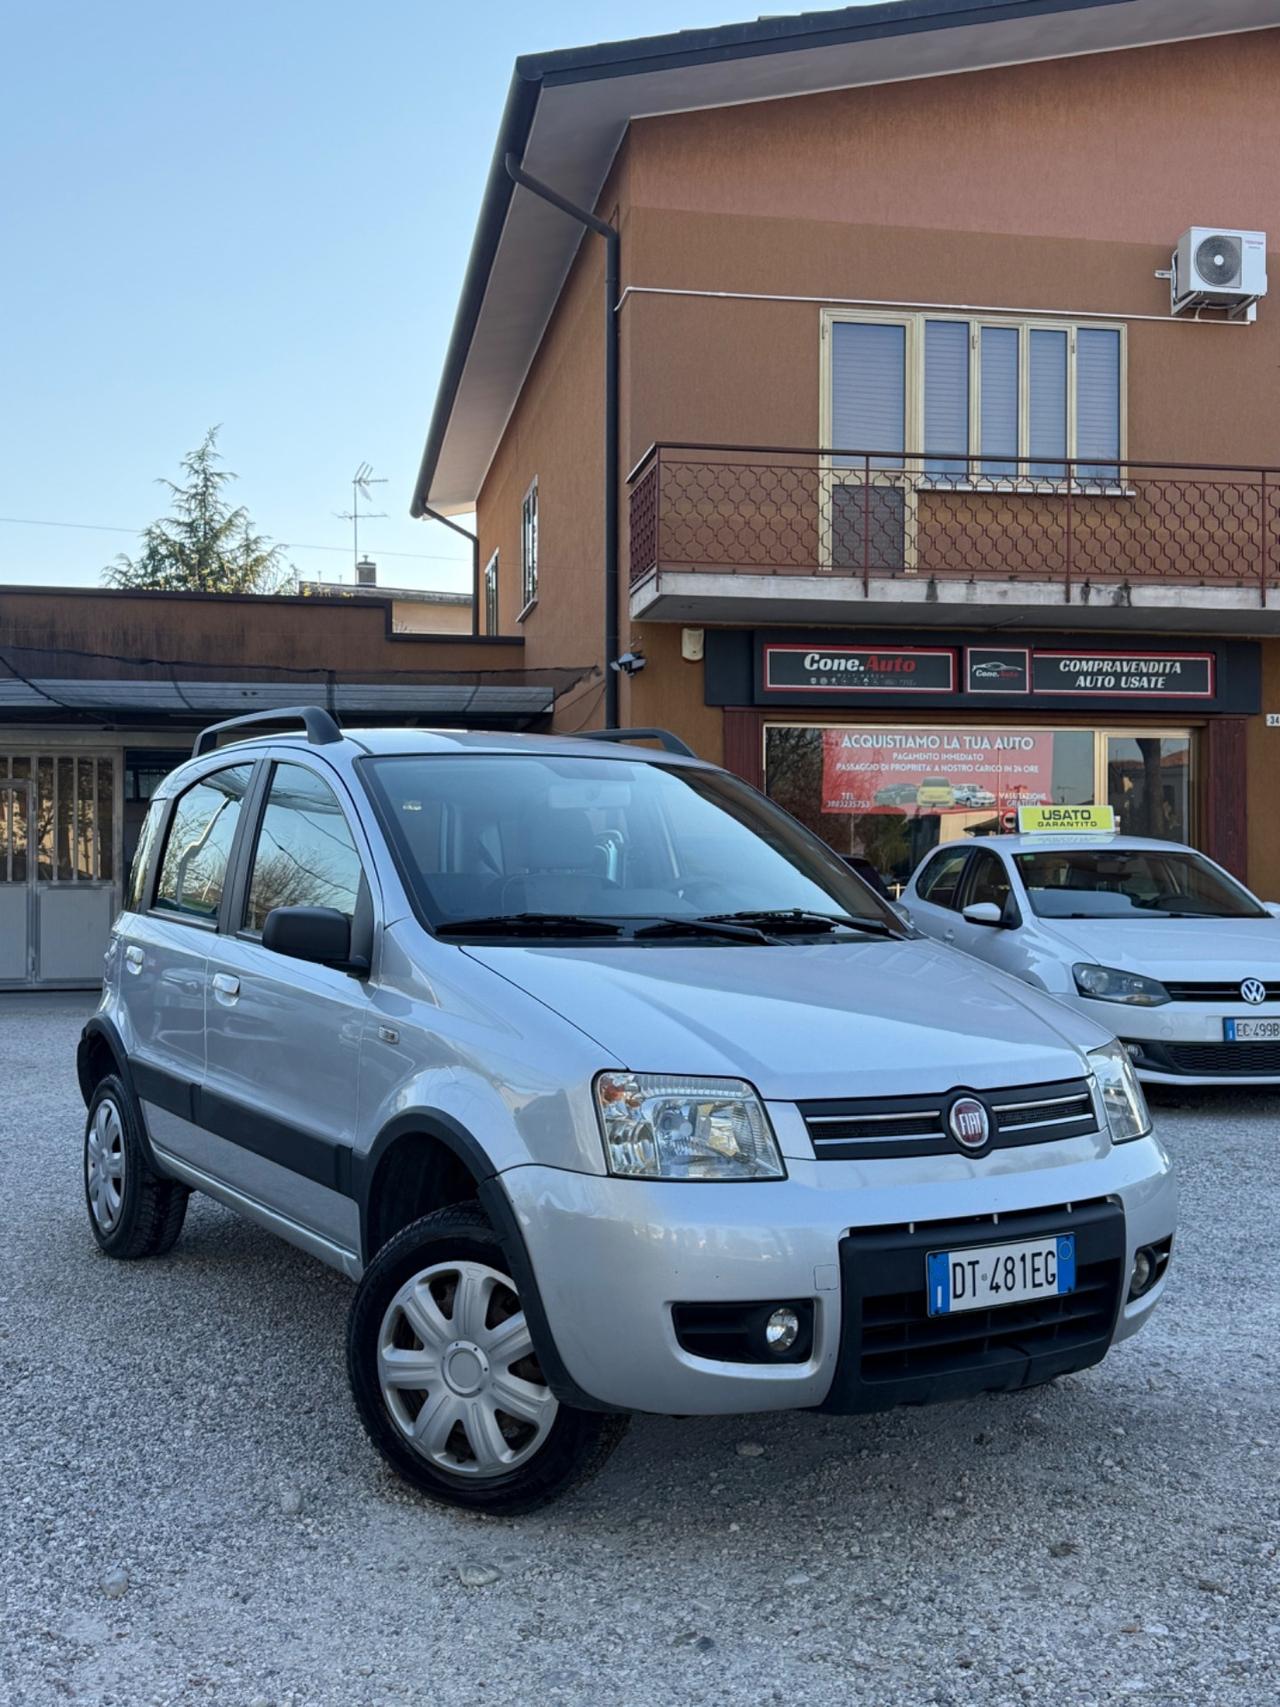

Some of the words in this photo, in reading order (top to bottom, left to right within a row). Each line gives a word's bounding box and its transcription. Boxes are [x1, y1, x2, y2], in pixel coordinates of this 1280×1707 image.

[804, 653, 916, 673] Cone.Auto
[1059, 660, 1182, 674] COMPRAVENDITA
[1075, 675, 1115, 688] AUTO
[1120, 676, 1166, 688] USATE
[841, 734, 940, 748] ACQUISTIAMO
[944, 735, 960, 749] LA
[964, 736, 991, 749] TUA
[994, 736, 1034, 750] AUTO
[893, 752, 939, 761] PAGAMENTO
[941, 753, 984, 761] IMMEDIATO
[836, 763, 879, 771] PASSAGGIO
[881, 763, 889, 771] DI
[942, 764, 973, 772] NOSTRO
[975, 764, 1002, 773] CARICO
[1004, 765, 1012, 773] IN
[1013, 765, 1022, 773] 24
[1023, 765, 1039, 773] ORE
[1042, 809, 1091, 821] USATO
[959, 1111, 981, 1136] FIAT
